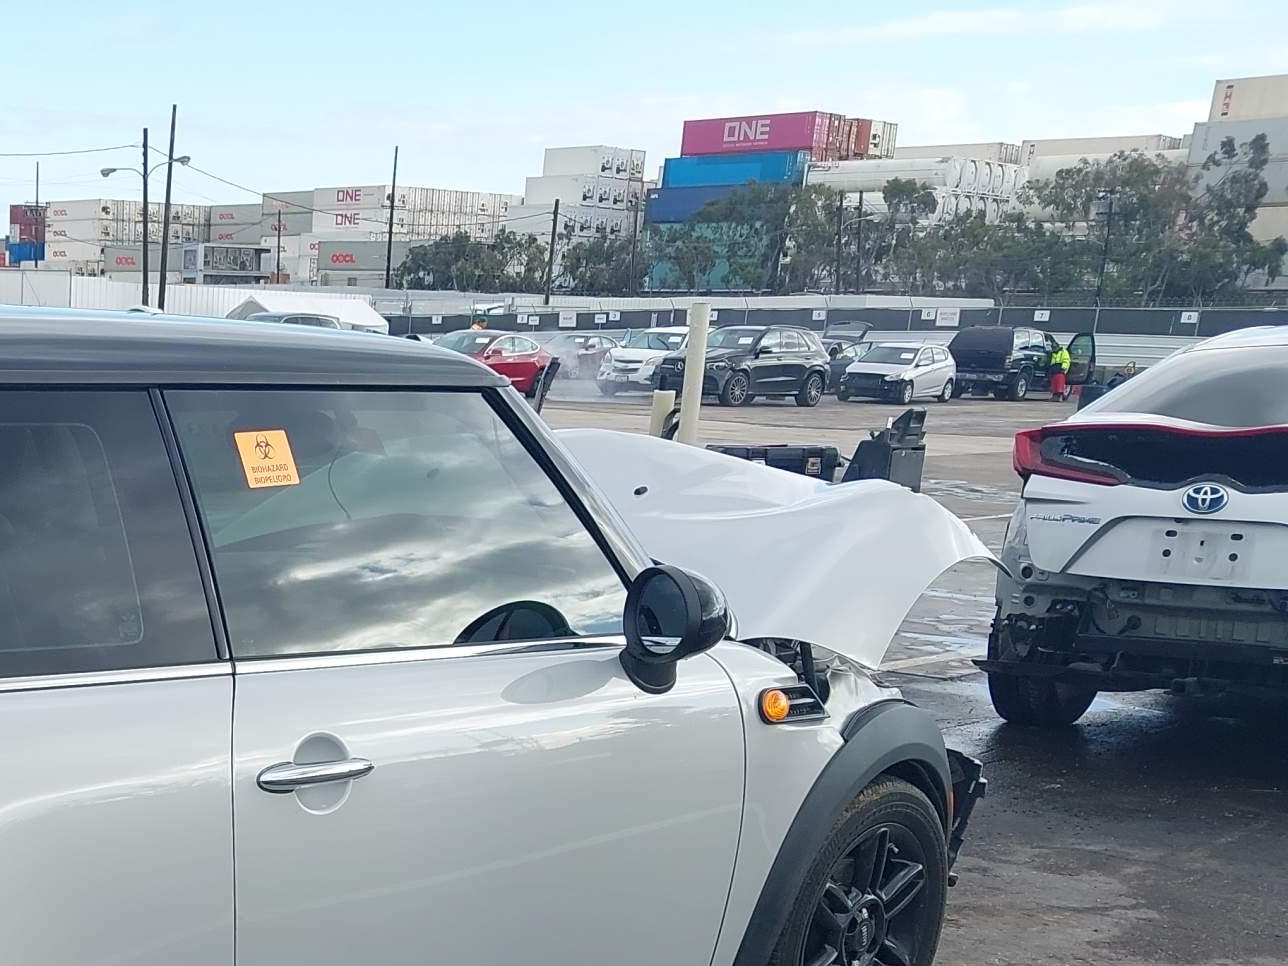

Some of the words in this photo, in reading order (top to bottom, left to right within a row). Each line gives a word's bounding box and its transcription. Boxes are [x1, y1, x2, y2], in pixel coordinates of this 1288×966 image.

[723, 120, 770, 141] ONE
[336, 189, 361, 203] ONE
[335, 212, 360, 226] ONE
[115, 255, 137, 266] OOCL
[331, 253, 356, 264] OOCL
[251, 464, 288, 473] BIOHAZARD
